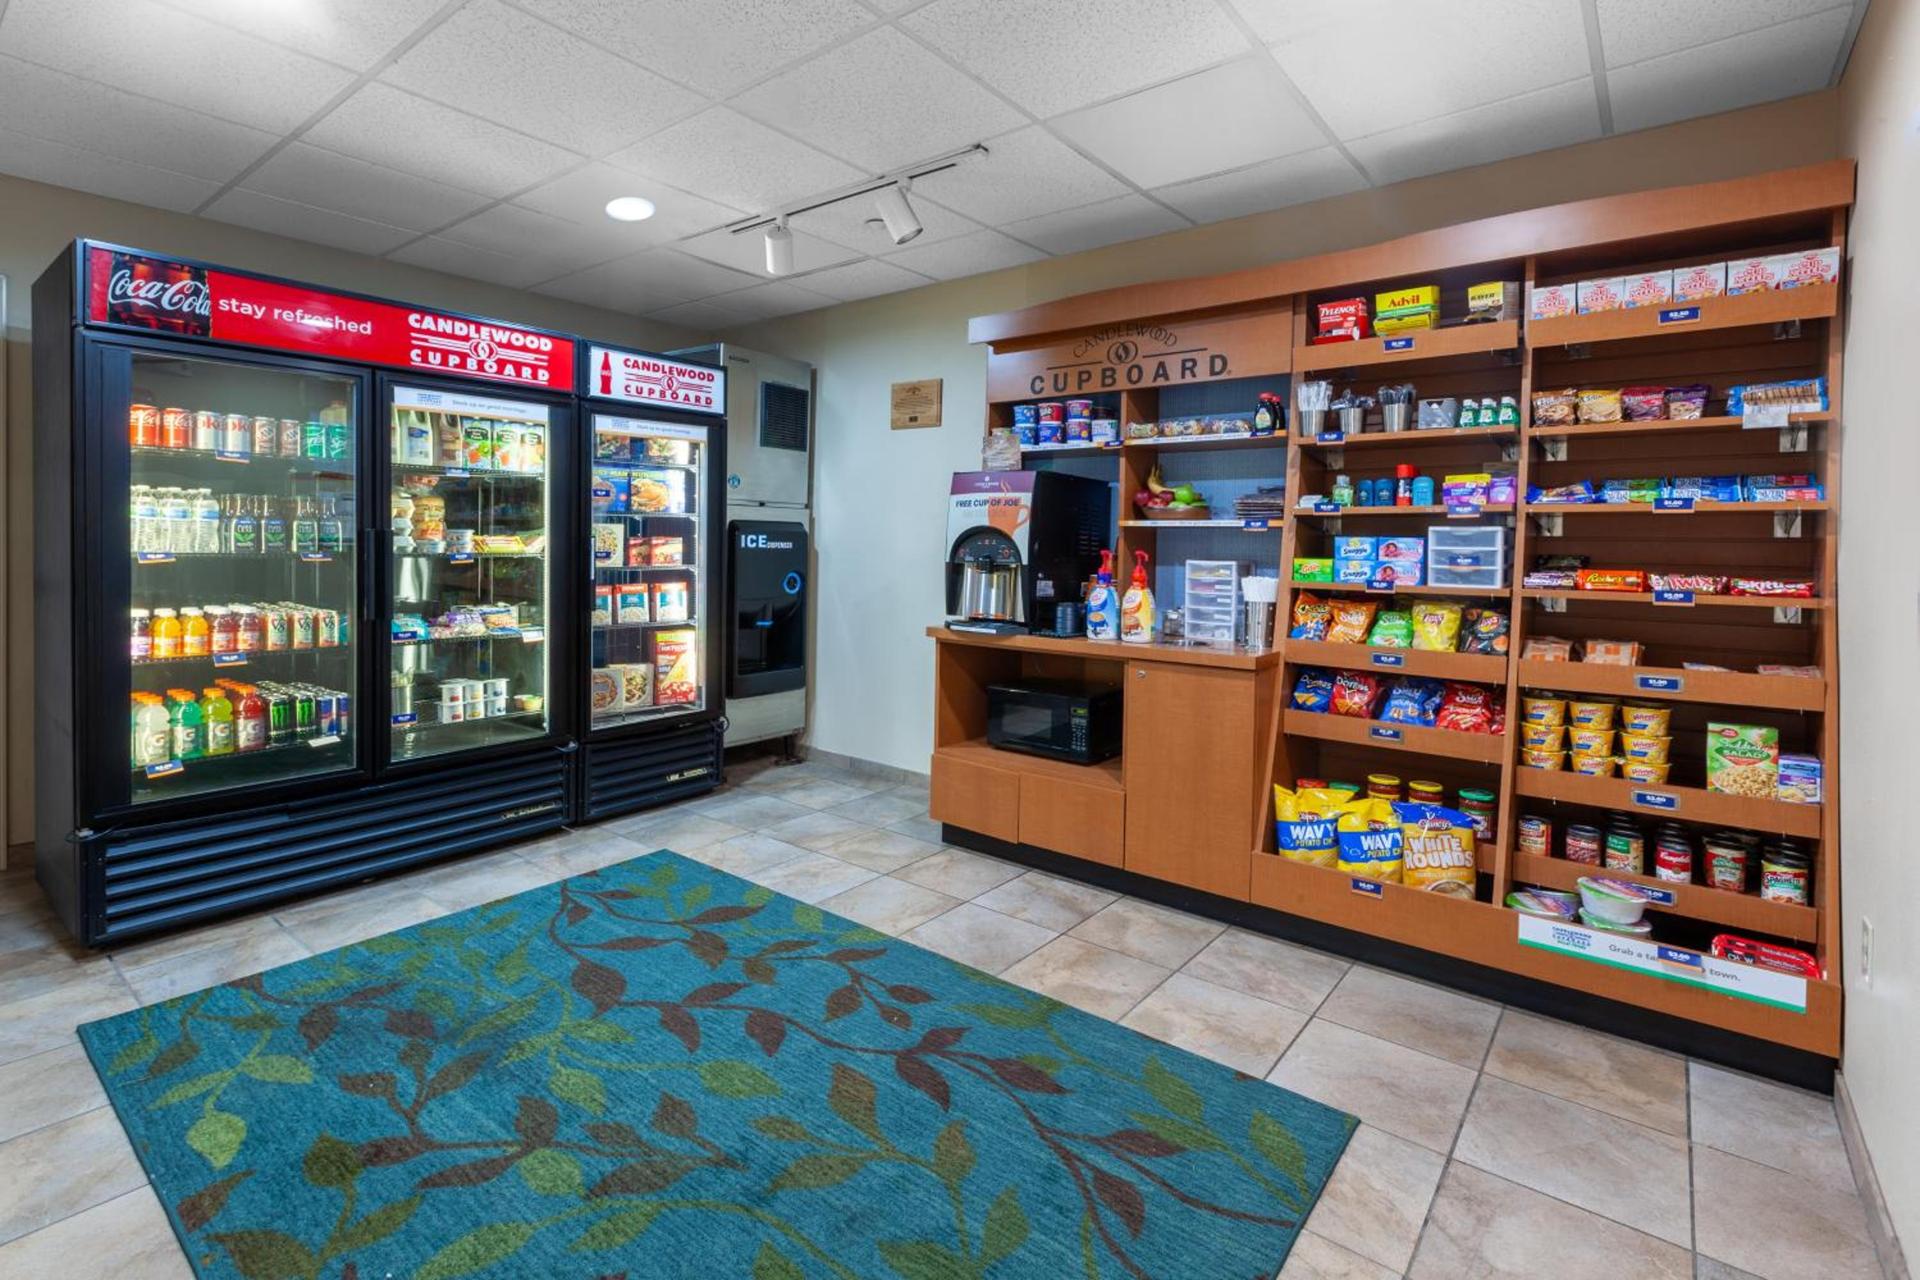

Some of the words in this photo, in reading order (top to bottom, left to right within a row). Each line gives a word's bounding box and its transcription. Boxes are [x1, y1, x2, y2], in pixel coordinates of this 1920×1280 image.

[108, 268, 212, 317] Coca-Cola
[1387, 293, 1421, 308] Advil
[218, 298, 266, 319] stay
[273, 307, 373, 336] refreshed
[407, 313, 553, 352] CANDLEWOOD
[1072, 322, 1178, 359] CANDLEWOOD
[409, 348, 551, 382] CUPBOARD
[622, 357, 716, 383] CANDLEWOOD
[1029, 353, 1229, 395] CUPBOARD
[623, 383, 714, 406] CUPBOARD
[973, 498, 989, 507] CUP
[990, 498, 1001, 507] OF
[741, 534, 768, 549] ICE
[1335, 675, 1370, 692] Doritos
[1289, 822, 1337, 840] WAVY
[1409, 833, 1463, 854] WHITE
[1403, 849, 1474, 870] ROUNDS
[1608, 943, 1634, 957] Grab
[1709, 967, 1742, 982] town.
